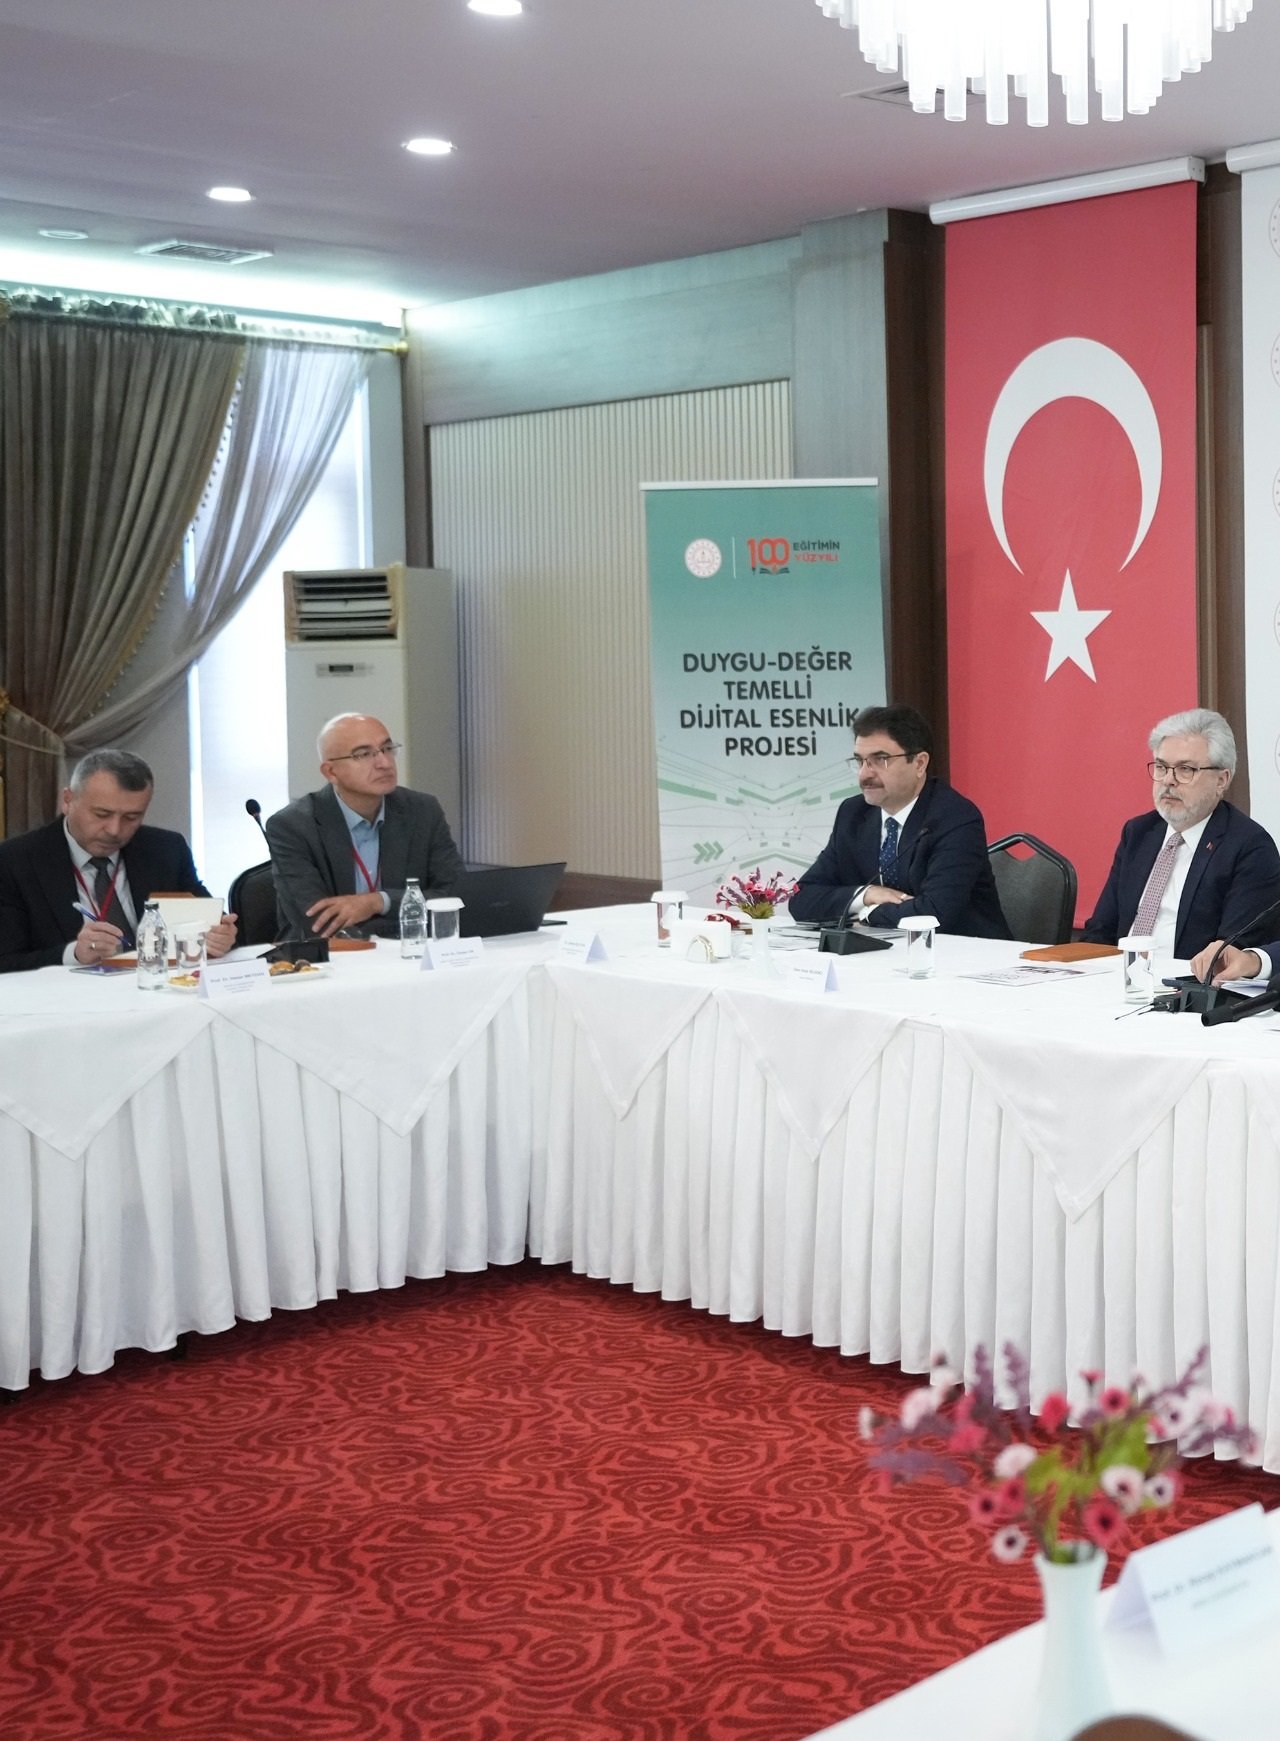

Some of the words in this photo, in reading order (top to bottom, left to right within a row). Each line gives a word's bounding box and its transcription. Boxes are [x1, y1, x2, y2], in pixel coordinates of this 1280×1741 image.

[747, 537, 791, 576] 100
[793, 539, 840, 551] EĞİTİMİN
[682, 645, 853, 673] DUYGU-DEĞER
[723, 674, 812, 700] TEMELLİ
[680, 703, 762, 729] DİJİTAL
[770, 702, 859, 728] ESENLİK
[725, 730, 817, 757] PROJESİ
